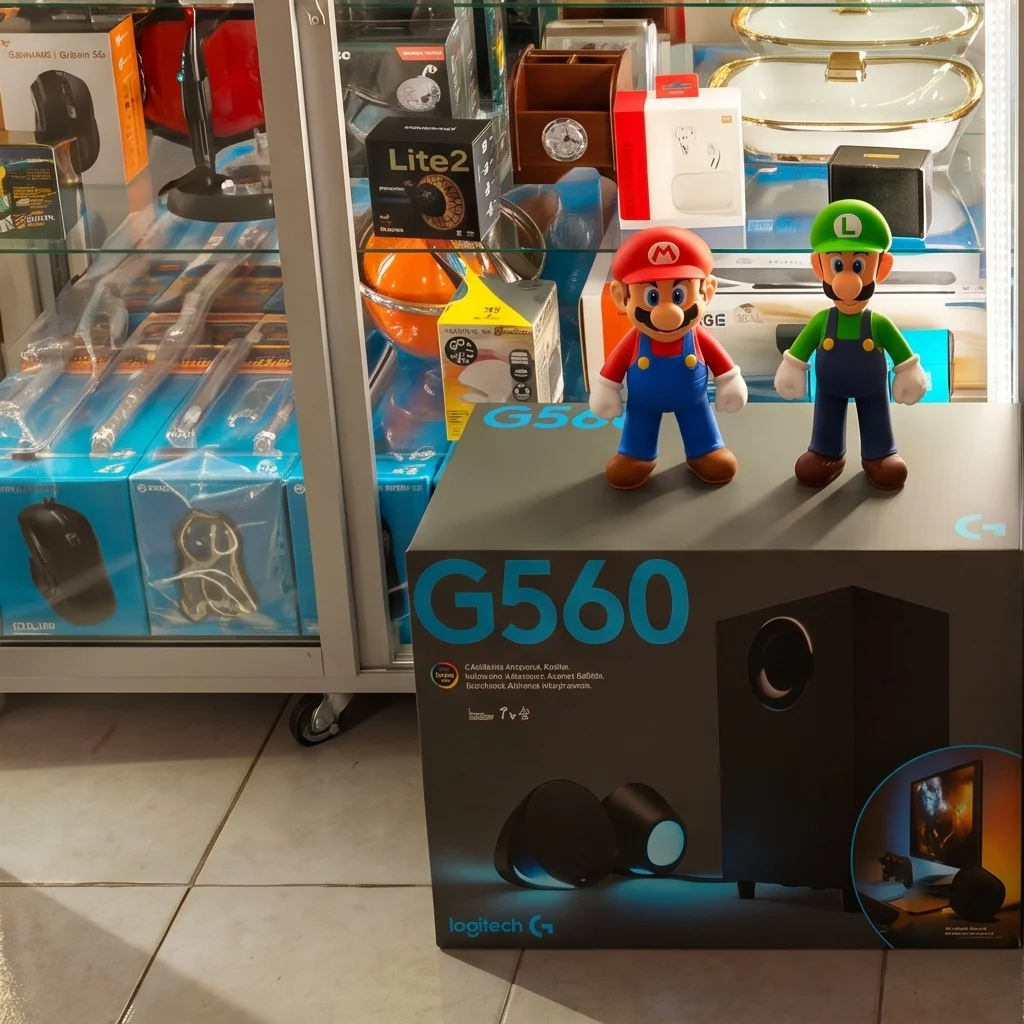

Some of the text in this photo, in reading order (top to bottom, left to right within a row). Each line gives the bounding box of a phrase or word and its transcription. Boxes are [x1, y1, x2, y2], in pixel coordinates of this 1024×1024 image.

[389, 148, 470, 173] Lite2
[841, 218, 857, 236] L
[652, 245, 677, 262] M
[483, 405, 626, 429] G56
[413, 558, 690, 645] G560
[449, 916, 524, 938] logitech
